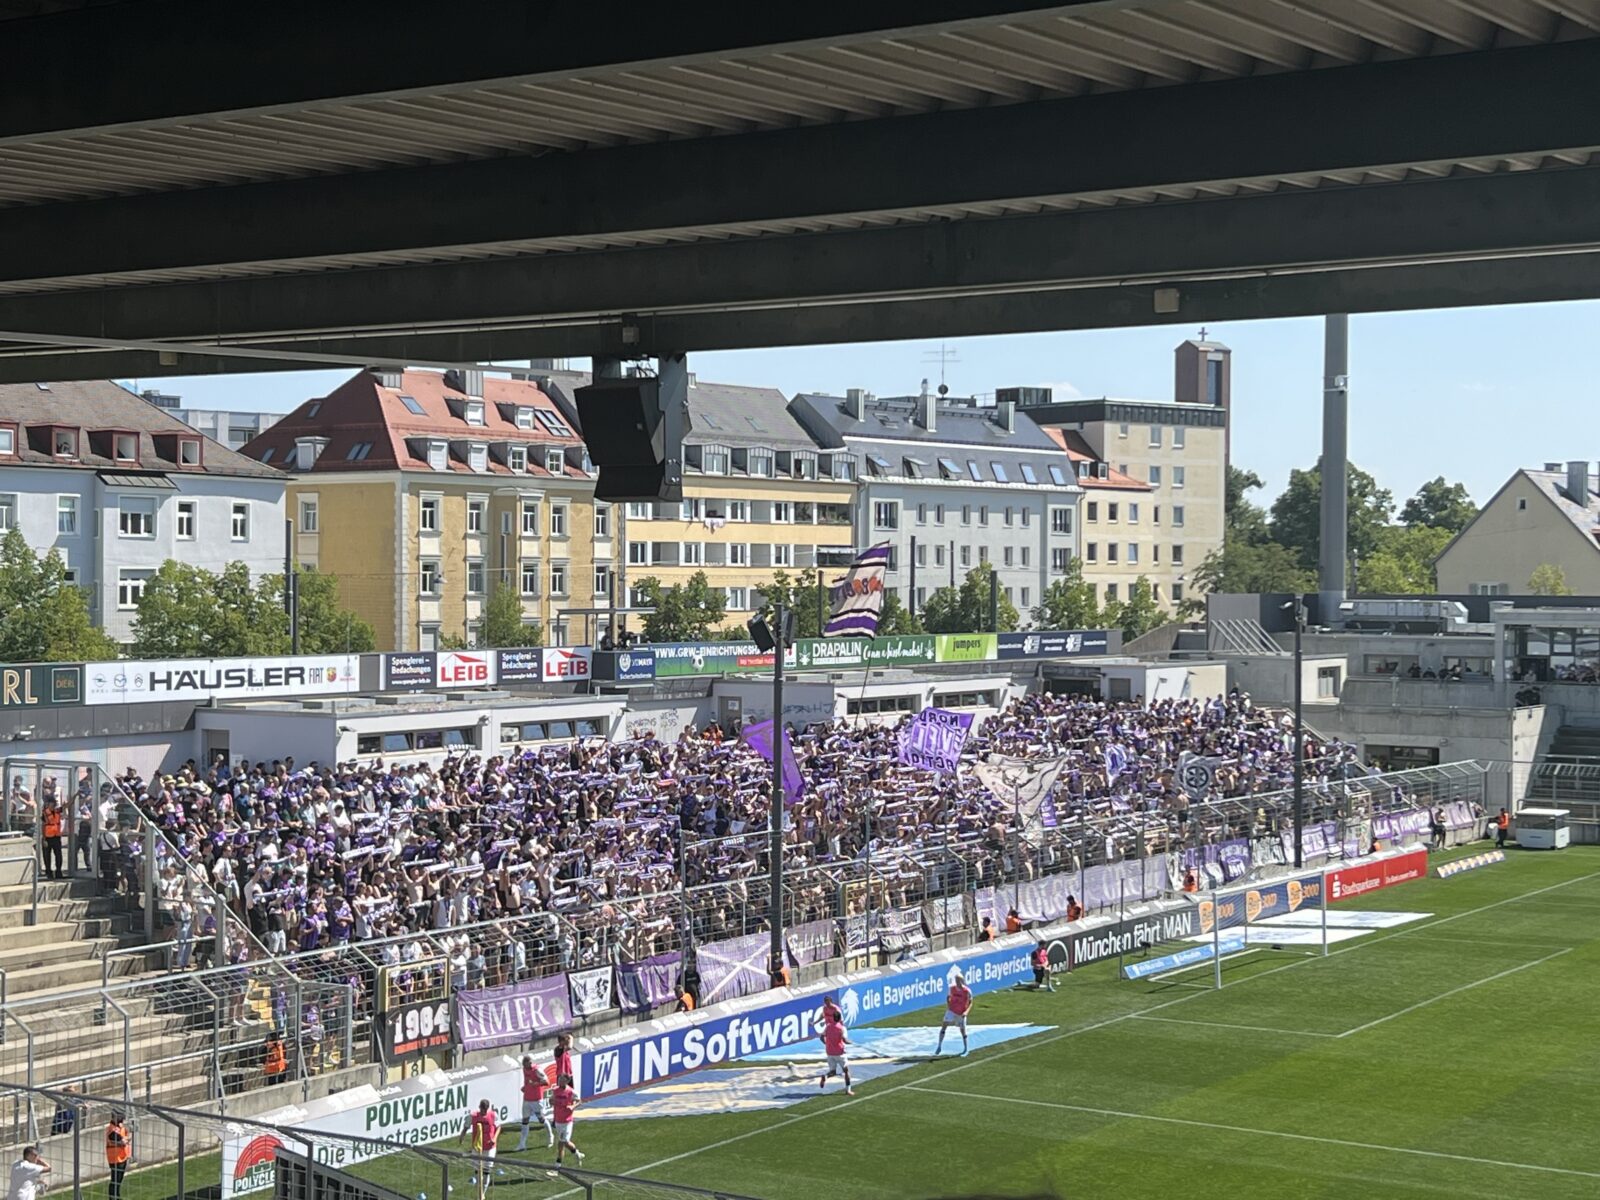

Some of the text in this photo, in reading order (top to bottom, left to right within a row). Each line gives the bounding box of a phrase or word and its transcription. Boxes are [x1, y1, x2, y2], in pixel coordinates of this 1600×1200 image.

[812, 642, 862, 658] DRAPALIN
[953, 637, 981, 651] jumpers
[309, 667, 324, 684] FIAT
[391, 666, 431, 675] Bedachungen
[441, 665, 488, 682] LEIB
[502, 662, 537, 670] Bedachungen
[546, 660, 588, 677] LEIB
[149, 666, 306, 692] HÄUSLER
[1074, 931, 1132, 964] München
[1133, 920, 1161, 948] fährt
[1163, 912, 1192, 940] MAN
[965, 966, 981, 985] die
[984, 953, 1032, 981] Bayerisch
[862, 975, 944, 1011] die Bayerische
[393, 1003, 450, 1044] 1984
[461, 995, 549, 1038] EIMER
[630, 1006, 829, 1085] IN-Software
[365, 1084, 468, 1131] POLYCLEAN
[317, 1145, 345, 1166] Die
[234, 1171, 276, 1191] POLYCLE
